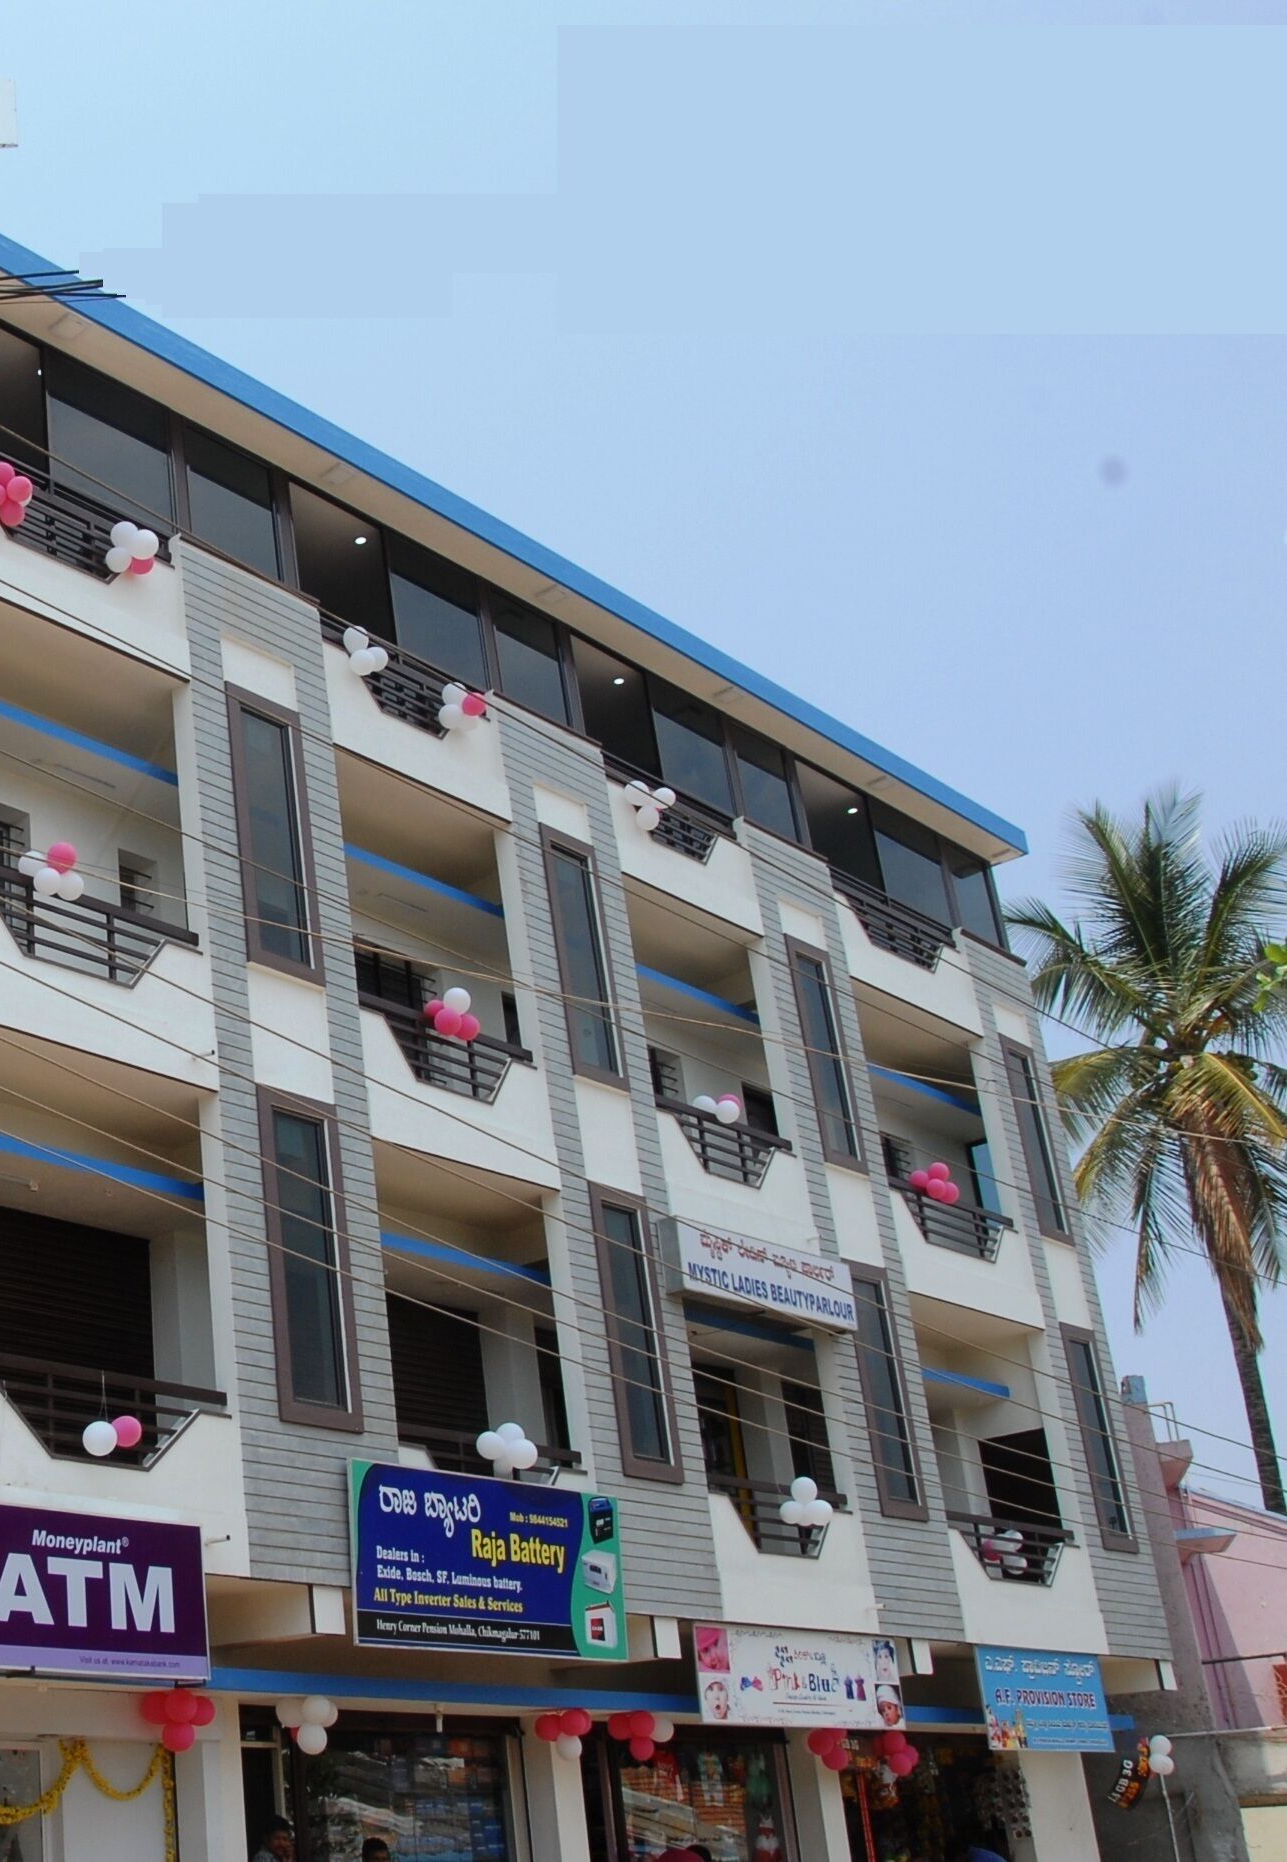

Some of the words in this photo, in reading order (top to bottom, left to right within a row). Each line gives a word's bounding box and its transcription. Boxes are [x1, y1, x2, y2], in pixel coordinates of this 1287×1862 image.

[687, 1262, 729, 1289] MYSTIC
[731, 1273, 768, 1299] LADIES
[770, 1283, 854, 1321] BEAUTYPARLOUR
[376, 1545, 408, 1562] Dealers
[471, 1528, 506, 1567] Raja
[510, 1533, 565, 1574] Battery
[452, 1572, 491, 1588] Luminous
[374, 1587, 388, 1601] All
[390, 1589, 412, 1606] Type
[414, 1591, 451, 1607] Inverter
[453, 1594, 476, 1609] Sales
[478, 1597, 485, 1609] &
[488, 1597, 523, 1612] Services
[376, 1620, 397, 1634] Henry
[398, 1620, 421, 1632] Corner
[422, 1622, 447, 1634] Pension
[79, 1655, 92, 1664] Visit
[111, 1659, 180, 1668] www.karnatakabank.com
[809, 1673, 840, 1692] Blue
[1016, 1689, 1065, 1707] PROVISION
[1067, 1692, 1096, 1709] STORE
